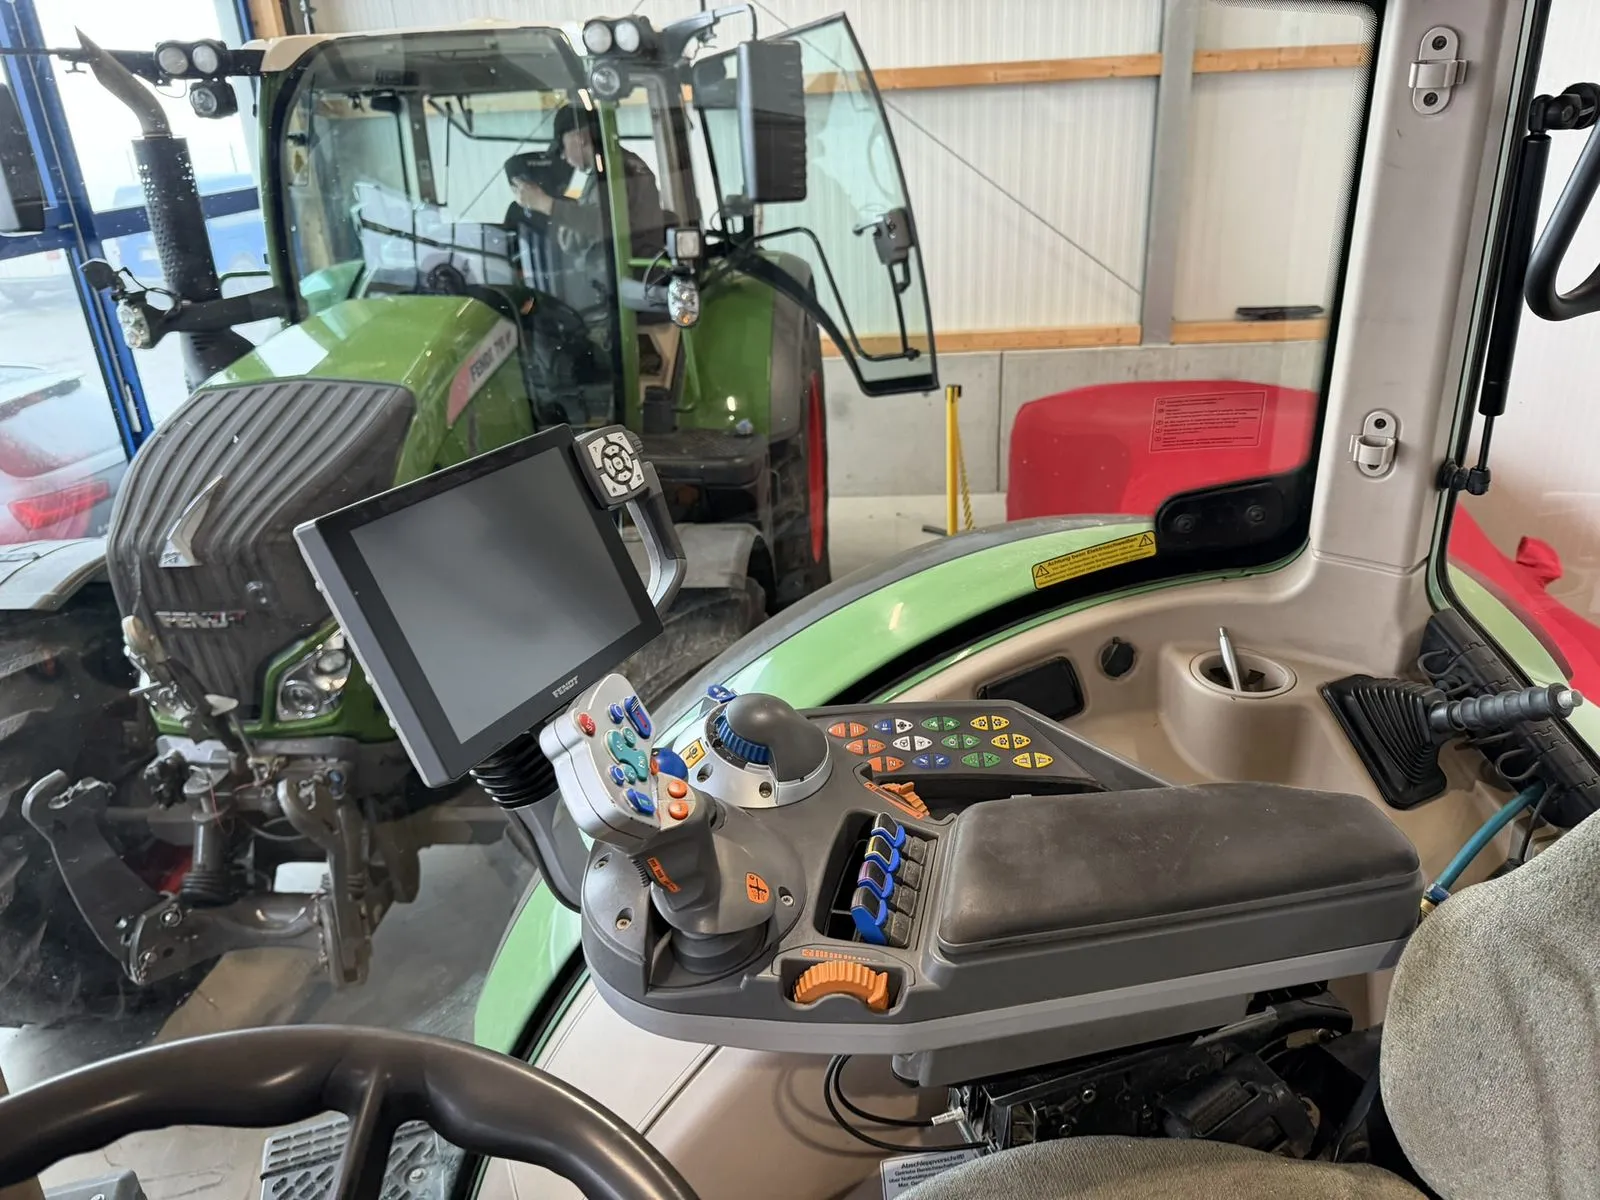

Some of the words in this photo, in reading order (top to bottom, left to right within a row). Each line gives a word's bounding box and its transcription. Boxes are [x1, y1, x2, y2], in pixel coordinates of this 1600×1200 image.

[1047, 555, 1071, 567] Achtung
[154, 610, 247, 629] FENDT
[552, 675, 578, 698] FENDT
